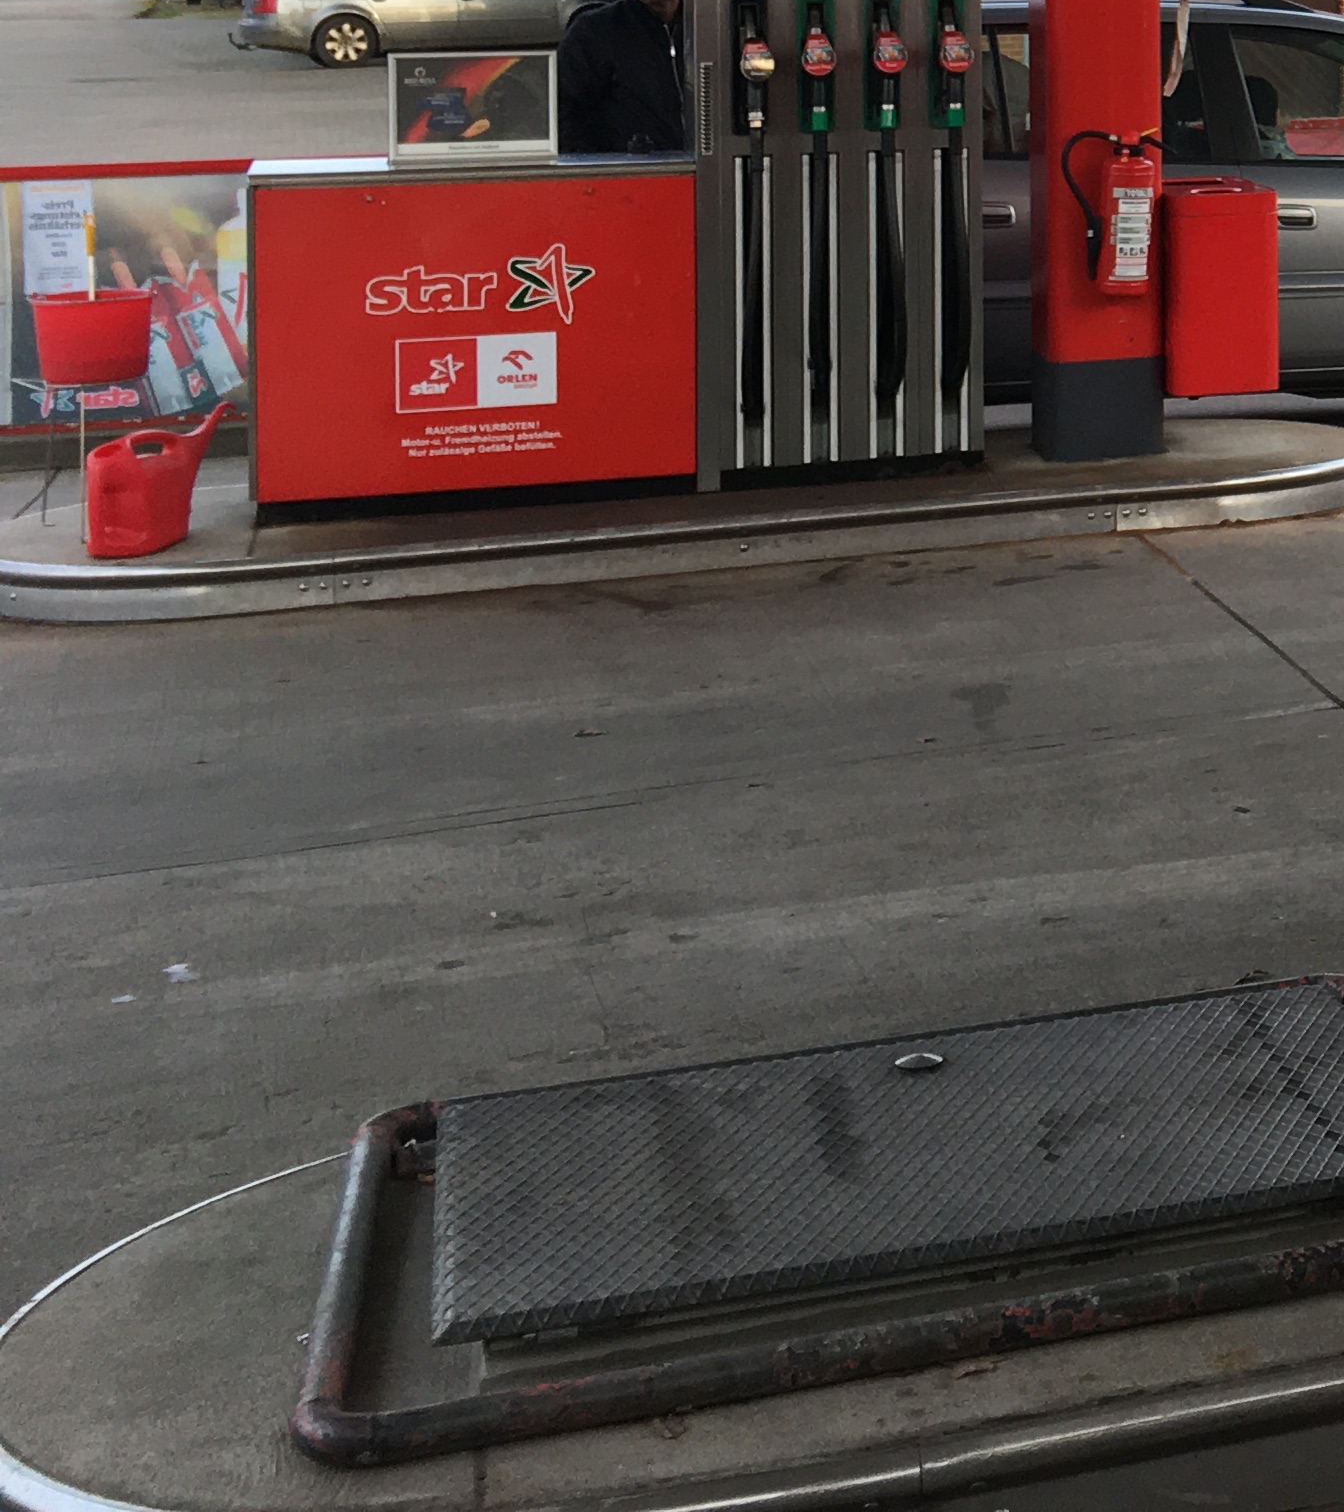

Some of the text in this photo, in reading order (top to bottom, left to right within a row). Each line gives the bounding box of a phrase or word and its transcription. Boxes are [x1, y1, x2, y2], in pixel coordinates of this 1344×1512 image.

[365, 264, 498, 316] star
[496, 373, 538, 385] ORLEN
[408, 380, 450, 396] star
